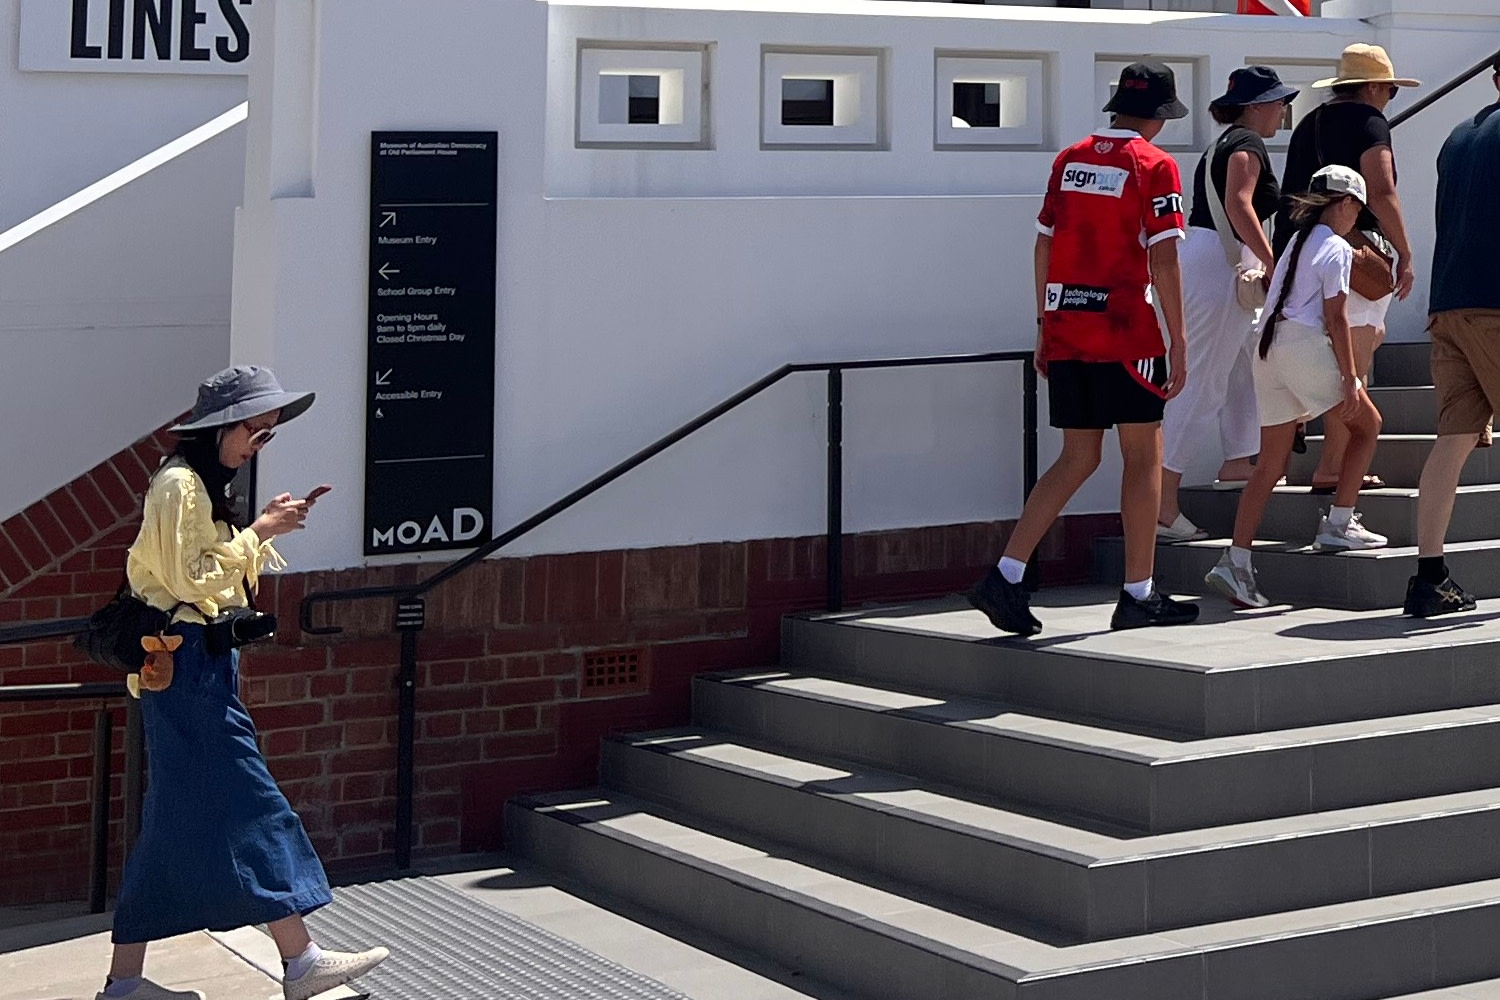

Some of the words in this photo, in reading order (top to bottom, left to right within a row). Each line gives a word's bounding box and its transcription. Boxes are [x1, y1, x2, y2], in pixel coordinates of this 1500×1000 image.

[378, 236, 414, 244] Museum
[415, 235, 437, 245] Entry
[377, 287, 406, 296] School
[407, 287, 433, 296] Group
[434, 286, 456, 296] Entry
[1064, 288, 1109, 301] technology
[1062, 297, 1088, 305] people
[377, 313, 412, 323] Opening
[396, 324, 405, 332] to
[407, 323, 426, 332] 5pm
[427, 322, 446, 332] daily
[377, 334, 405, 343] Closed
[406, 334, 447, 342] Christmas
[448, 332, 465, 342] Day
[375, 390, 419, 400] Accessible
[420, 390, 442, 399] Entry
[373, 507, 484, 547] MOAD
